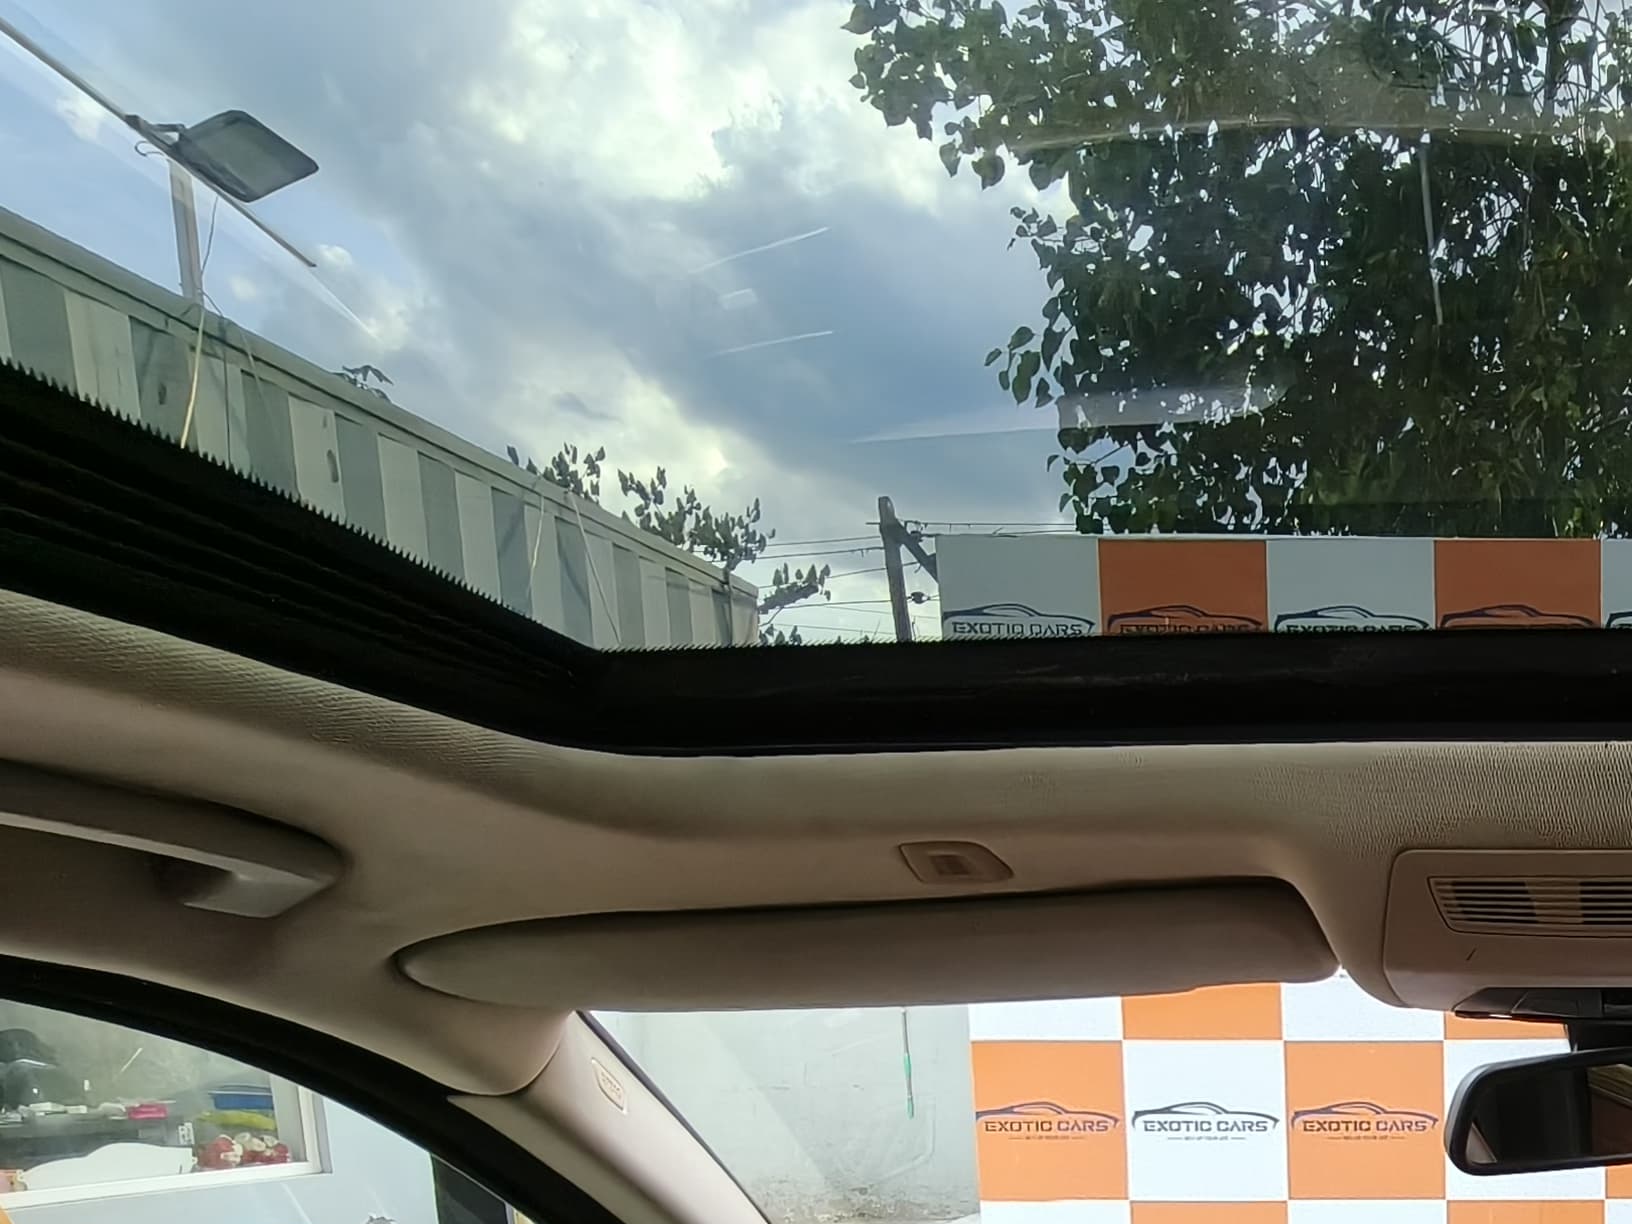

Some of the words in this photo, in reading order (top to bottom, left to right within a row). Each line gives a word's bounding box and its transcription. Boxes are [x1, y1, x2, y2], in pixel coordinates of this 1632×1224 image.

[985, 1121, 1053, 1132] EXOTIC
[1057, 1120, 1109, 1132] CARS
[1143, 1120, 1212, 1132] EXOTIC
[1217, 1120, 1268, 1132] CARS
[1302, 1120, 1371, 1132] EXOTIC
[1376, 1120, 1427, 1132] CARS
